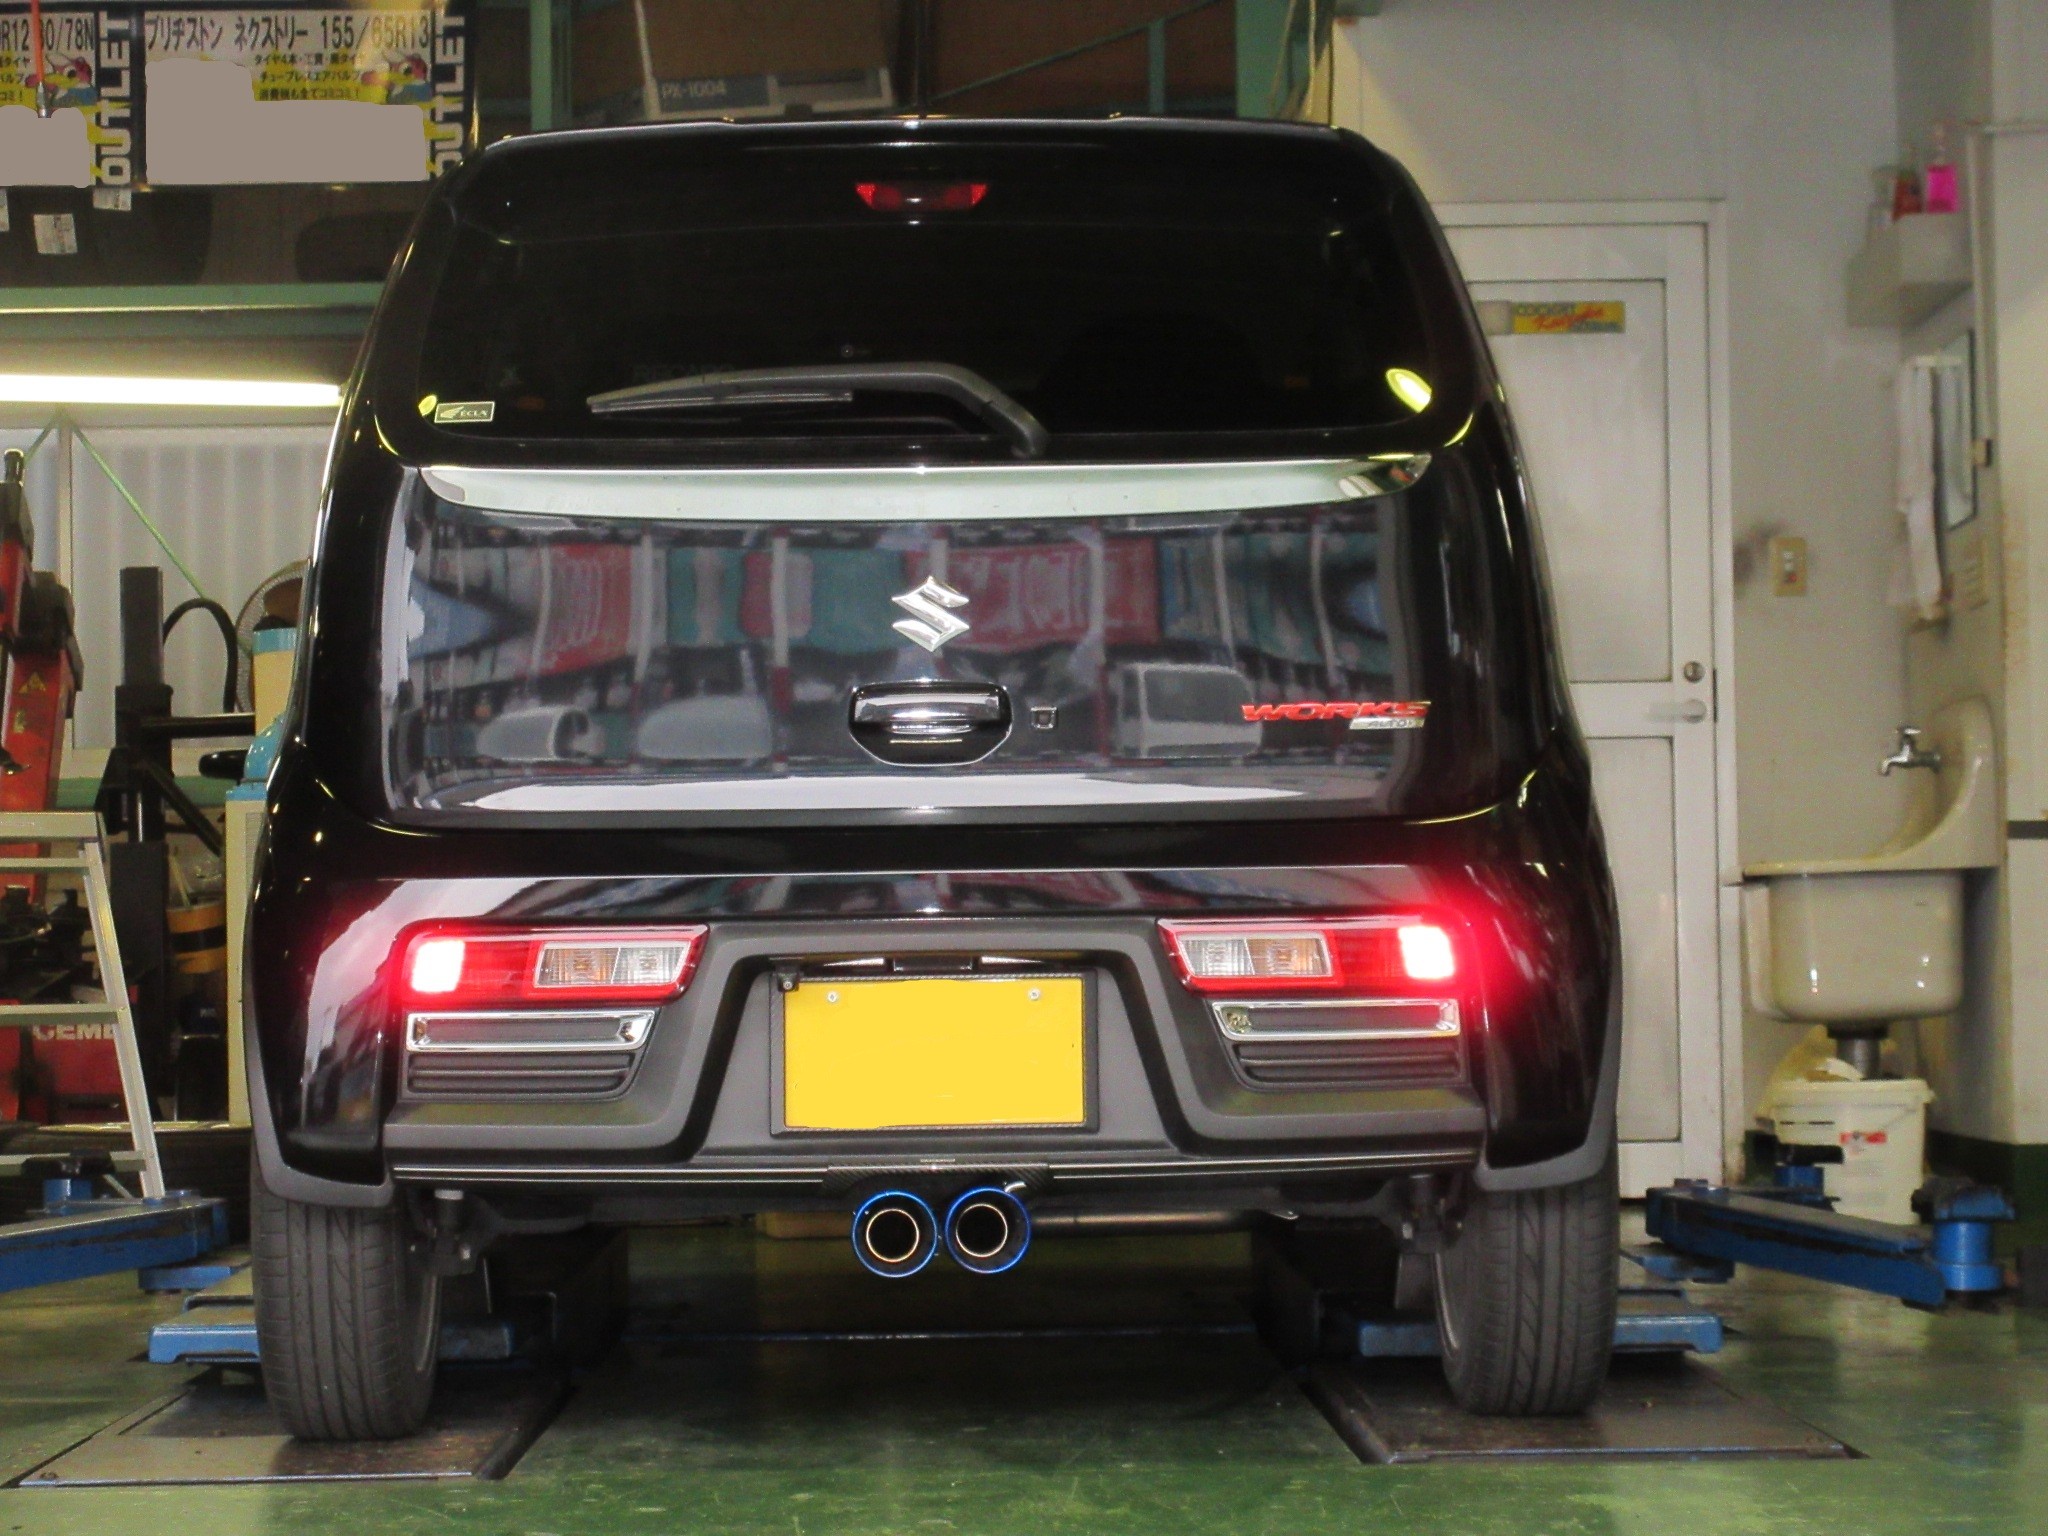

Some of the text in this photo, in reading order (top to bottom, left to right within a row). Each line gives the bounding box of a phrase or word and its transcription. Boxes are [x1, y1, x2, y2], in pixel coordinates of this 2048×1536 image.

[234, 15, 308, 51] ネクストリー
[320, 15, 430, 50] 155/65R13
[98, 10, 132, 186] OUTLET
[1242, 702, 1431, 721] WORKS
